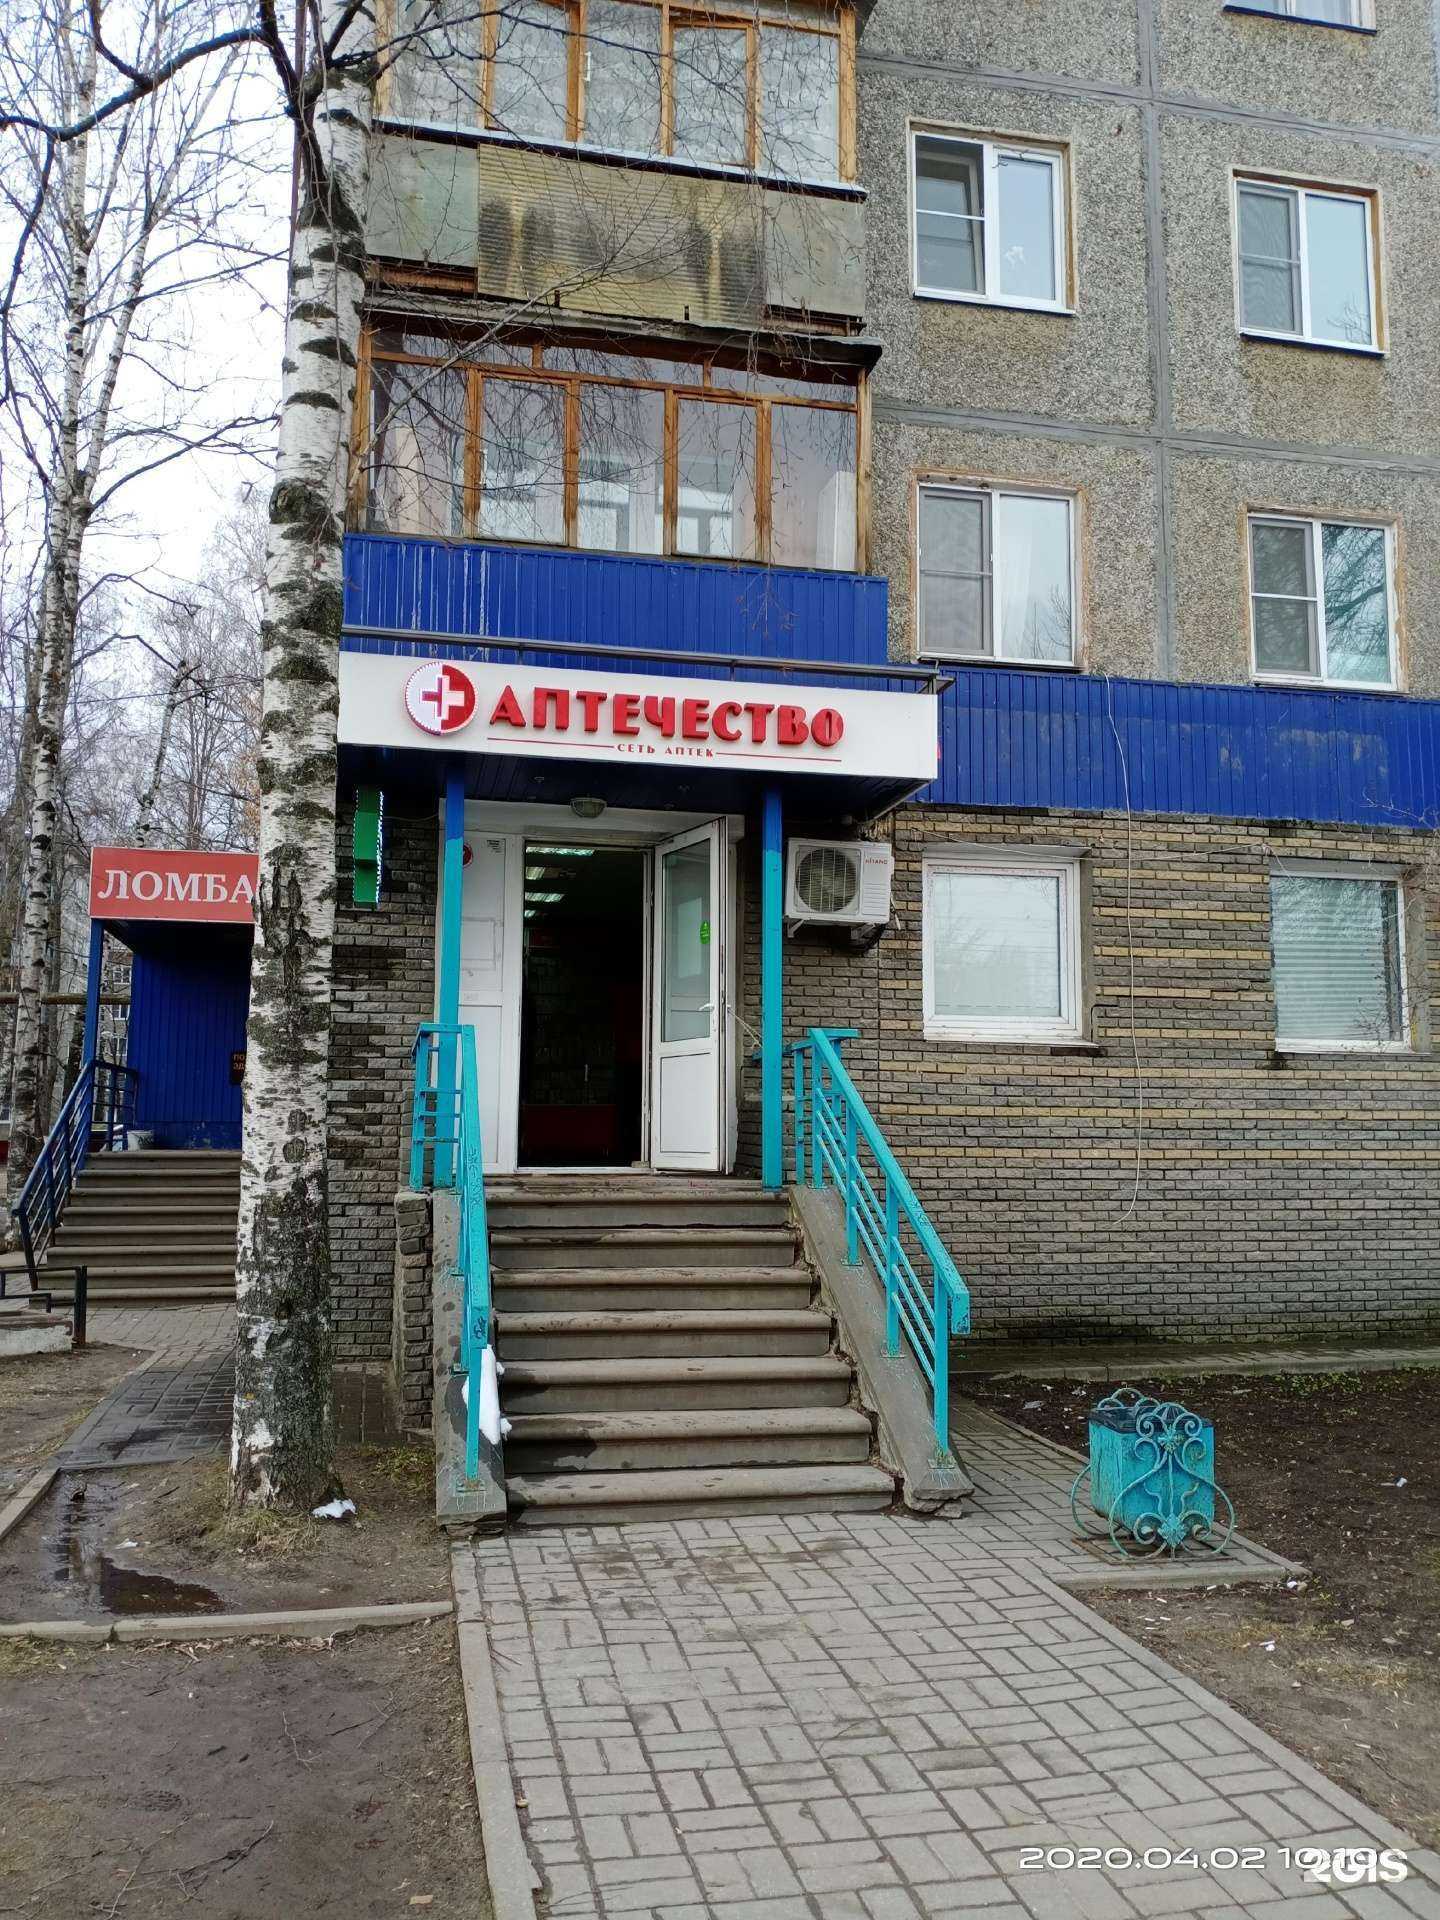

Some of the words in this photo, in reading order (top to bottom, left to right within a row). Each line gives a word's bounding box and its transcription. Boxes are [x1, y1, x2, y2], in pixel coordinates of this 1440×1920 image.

[489, 684, 845, 747] АПТЕЧЕСТВО
[617, 743, 656, 754] СЕТЬ
[664, 745, 714, 758] АПТЕК
